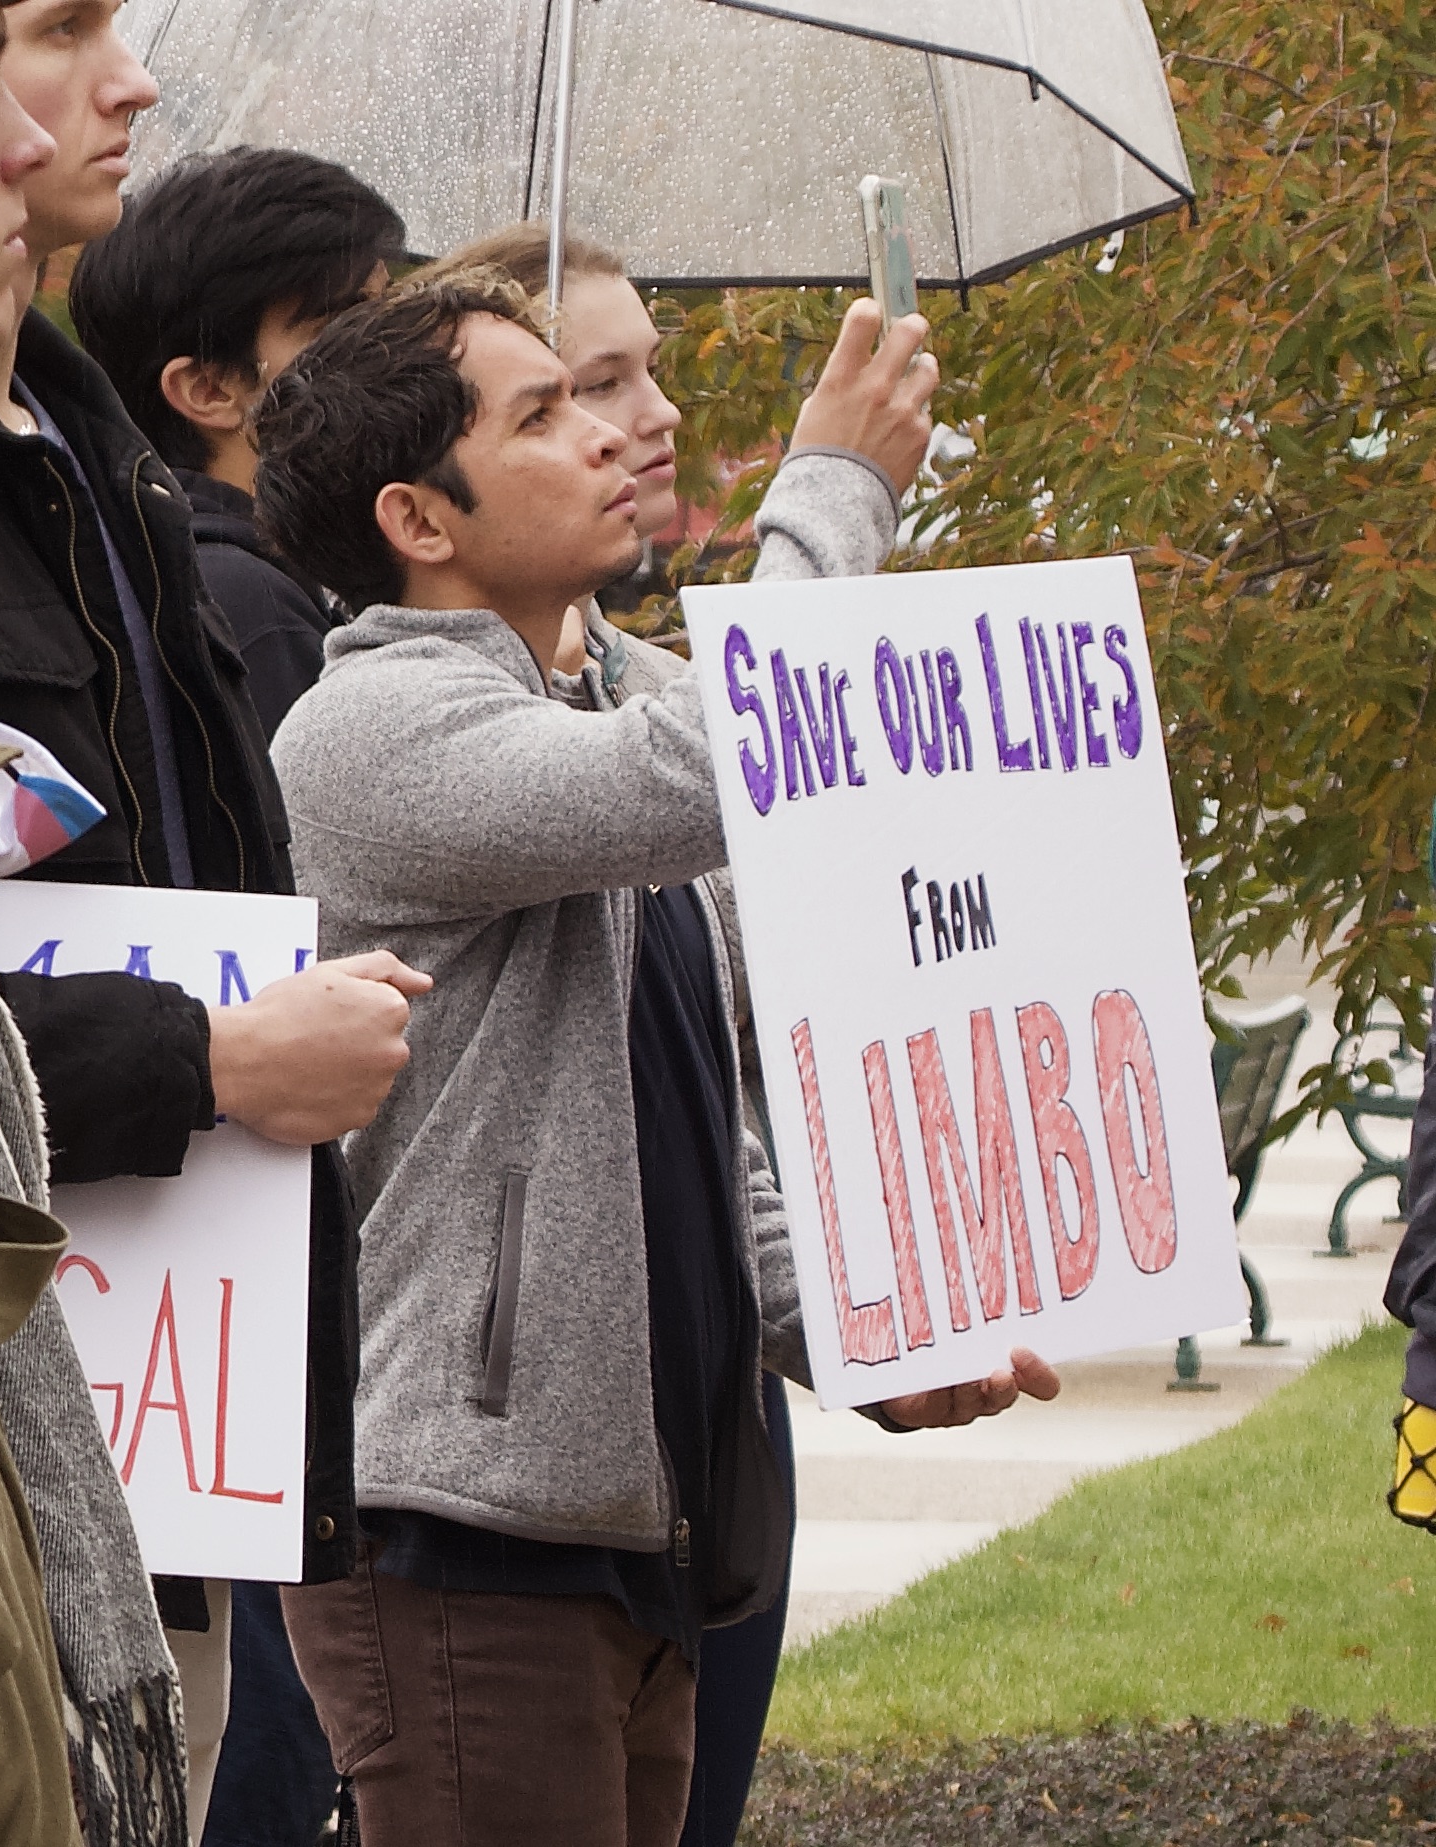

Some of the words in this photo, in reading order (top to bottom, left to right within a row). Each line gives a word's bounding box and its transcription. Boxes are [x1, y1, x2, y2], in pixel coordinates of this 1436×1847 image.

[723, 622, 868, 818] SAVE
[873, 634, 974, 778] OUR
[974, 612, 1143, 774] LIVES
[900, 864, 998, 968] FROM
[789, 988, 1178, 1367] LIMBO
